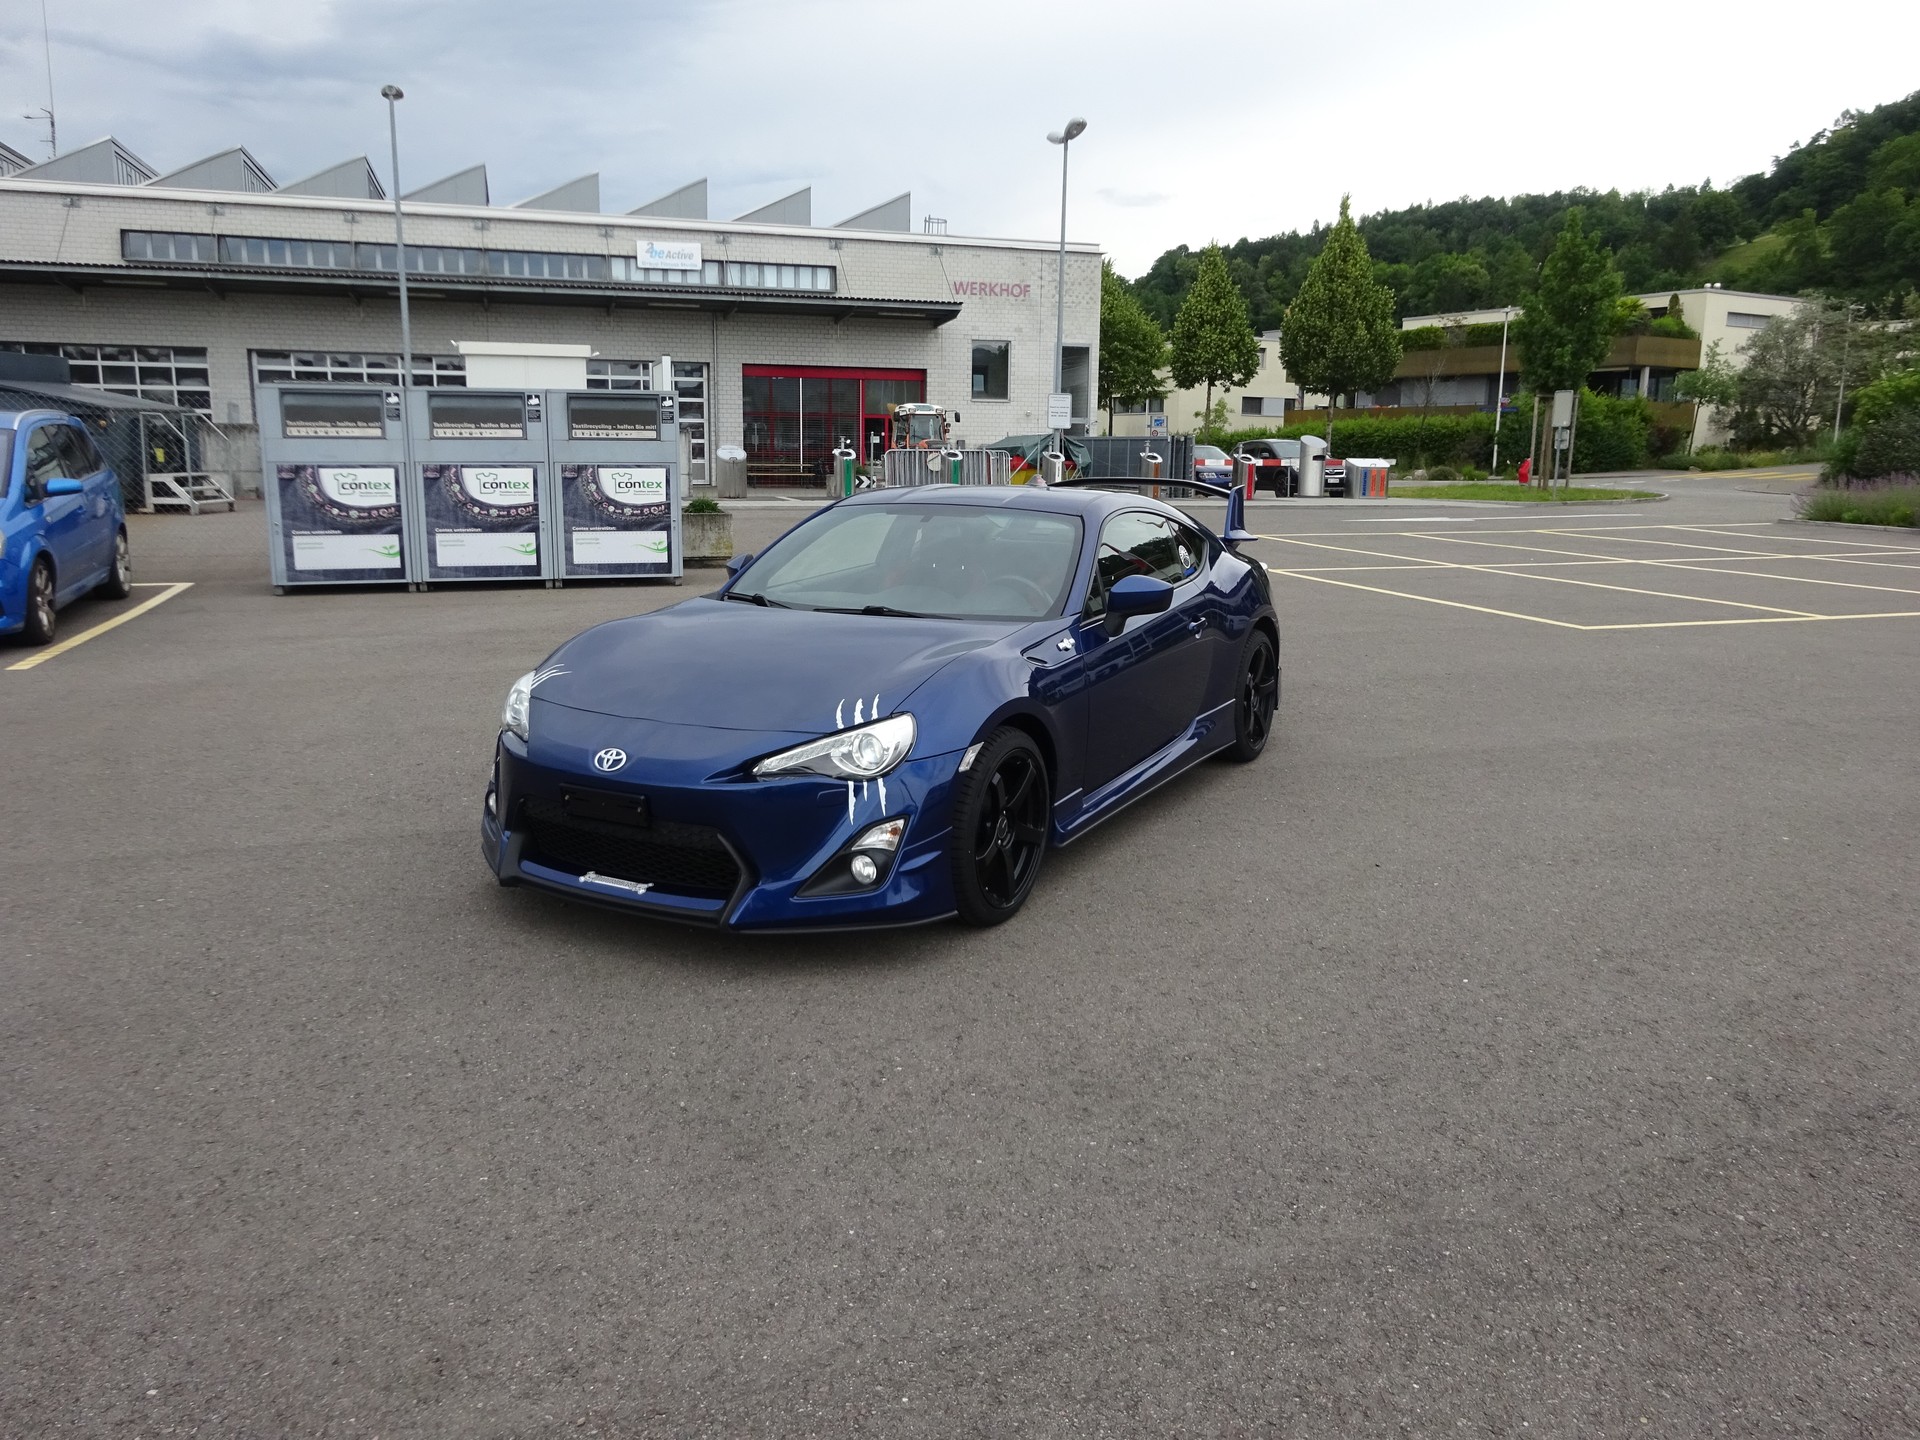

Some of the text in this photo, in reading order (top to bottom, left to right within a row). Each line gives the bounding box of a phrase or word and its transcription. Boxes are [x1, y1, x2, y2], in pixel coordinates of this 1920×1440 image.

[665, 249, 694, 260] Active
[953, 281, 1031, 297] WERKHOF
[341, 480, 392, 490] contex
[482, 480, 530, 490] contex
[618, 480, 663, 489] contex
